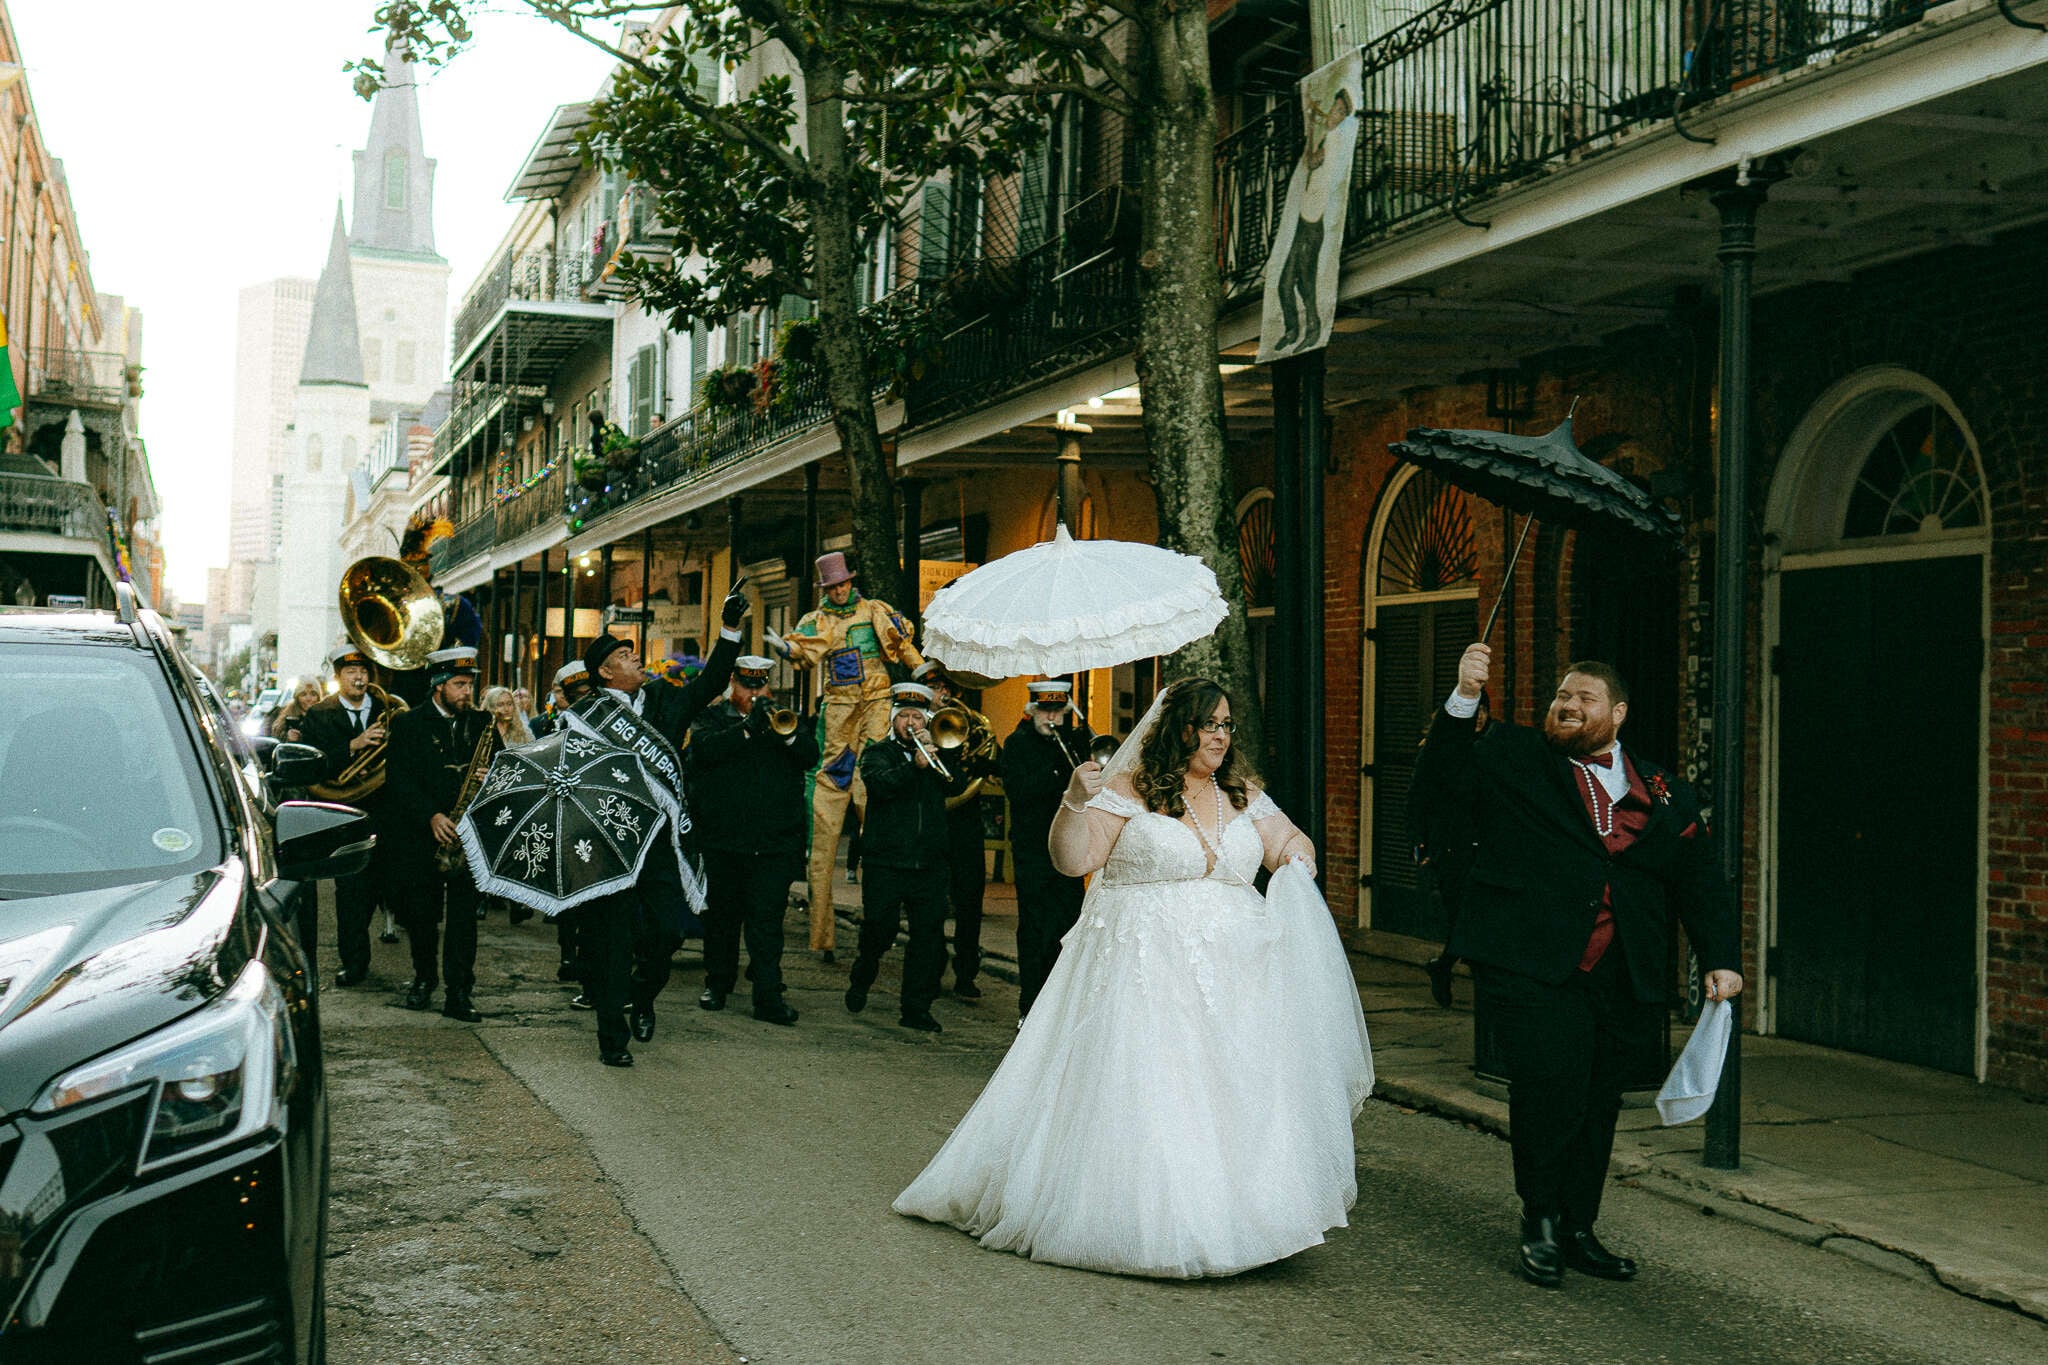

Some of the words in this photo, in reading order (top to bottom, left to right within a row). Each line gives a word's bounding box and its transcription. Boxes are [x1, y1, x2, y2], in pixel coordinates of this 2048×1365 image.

[610, 717, 637, 742] BIG
[631, 735, 662, 763] FUN
[655, 755, 682, 800] BRAS
